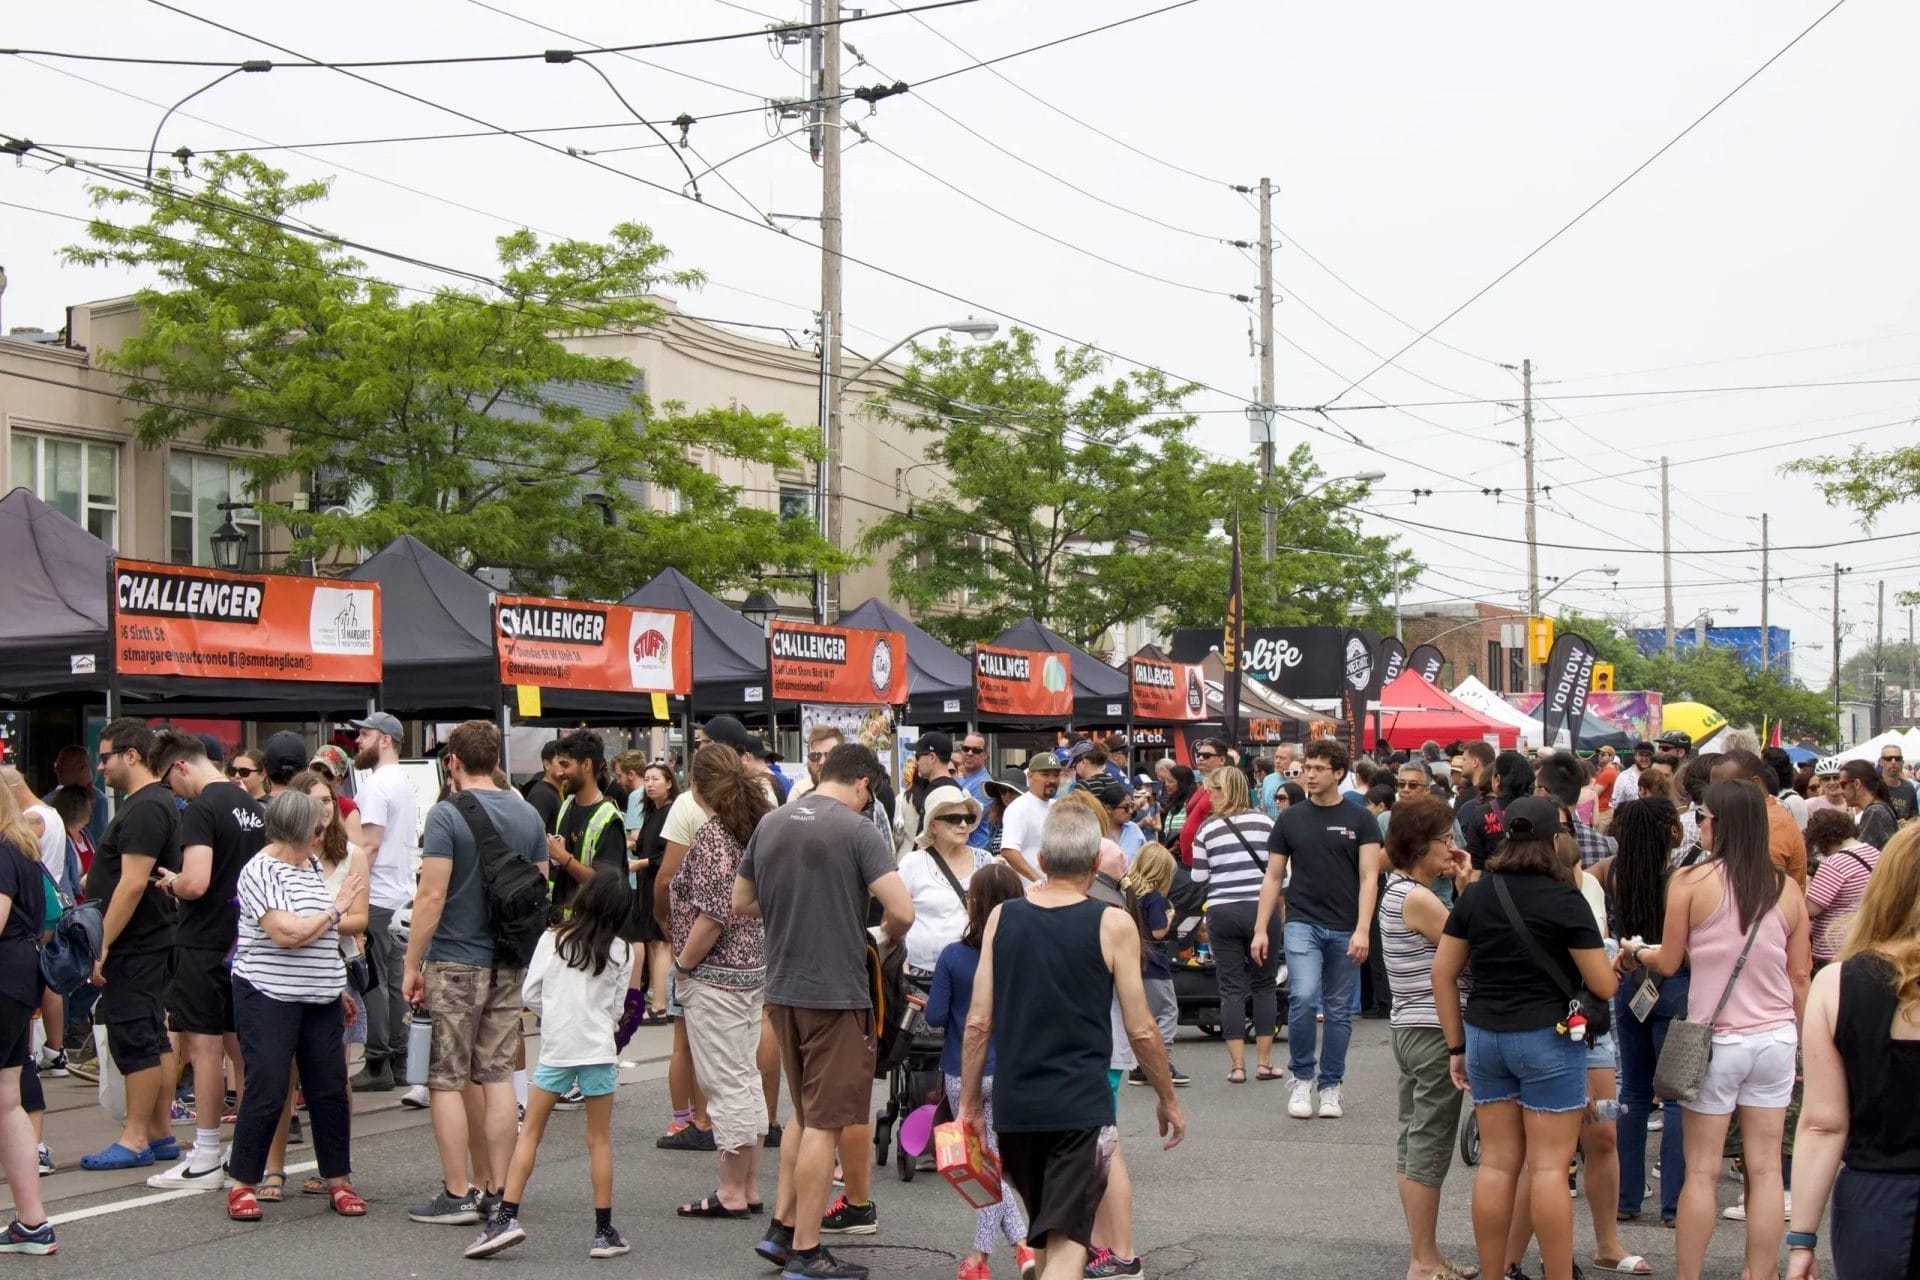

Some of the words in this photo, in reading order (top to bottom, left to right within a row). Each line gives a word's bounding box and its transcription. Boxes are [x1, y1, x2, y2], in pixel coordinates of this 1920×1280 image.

[118, 574, 261, 618] CHALLENGER
[130, 624, 153, 640] Sixth
[155, 625, 165, 641] St
[772, 632, 846, 661] CHALLENGER
[979, 652, 1030, 679] CALLNGER
[1382, 651, 1403, 689] KOW
[1550, 647, 1584, 712] VODKOW
[1571, 654, 1594, 716] VODKOW
[1147, 733, 1166, 743] co.
